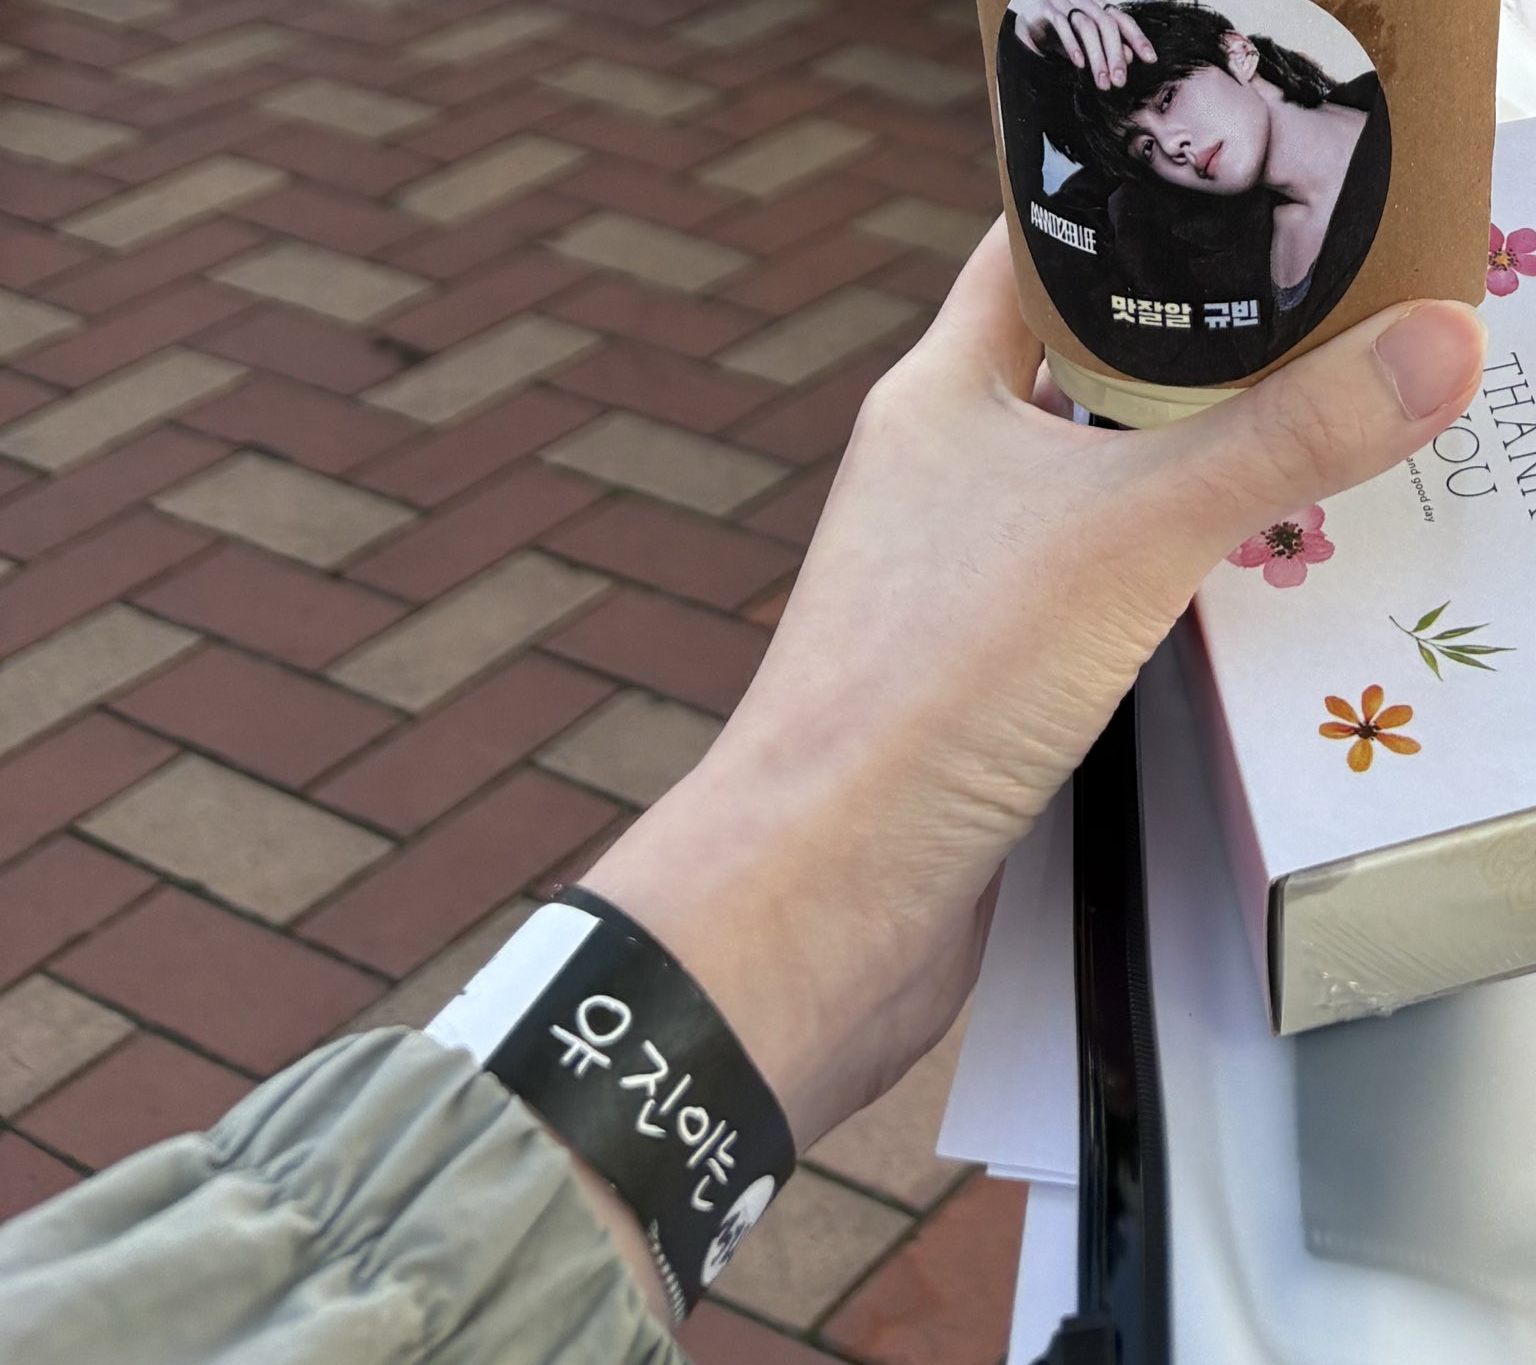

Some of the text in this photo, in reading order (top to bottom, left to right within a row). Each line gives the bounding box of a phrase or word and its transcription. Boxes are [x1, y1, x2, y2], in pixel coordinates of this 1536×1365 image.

[1111, 294, 1259, 329] 맛잘알 규빈
[1433, 413, 1498, 498] OU
[1410, 477, 1431, 503] good
[1422, 504, 1436, 523] day
[549, 994, 739, 1212] 유진이는
